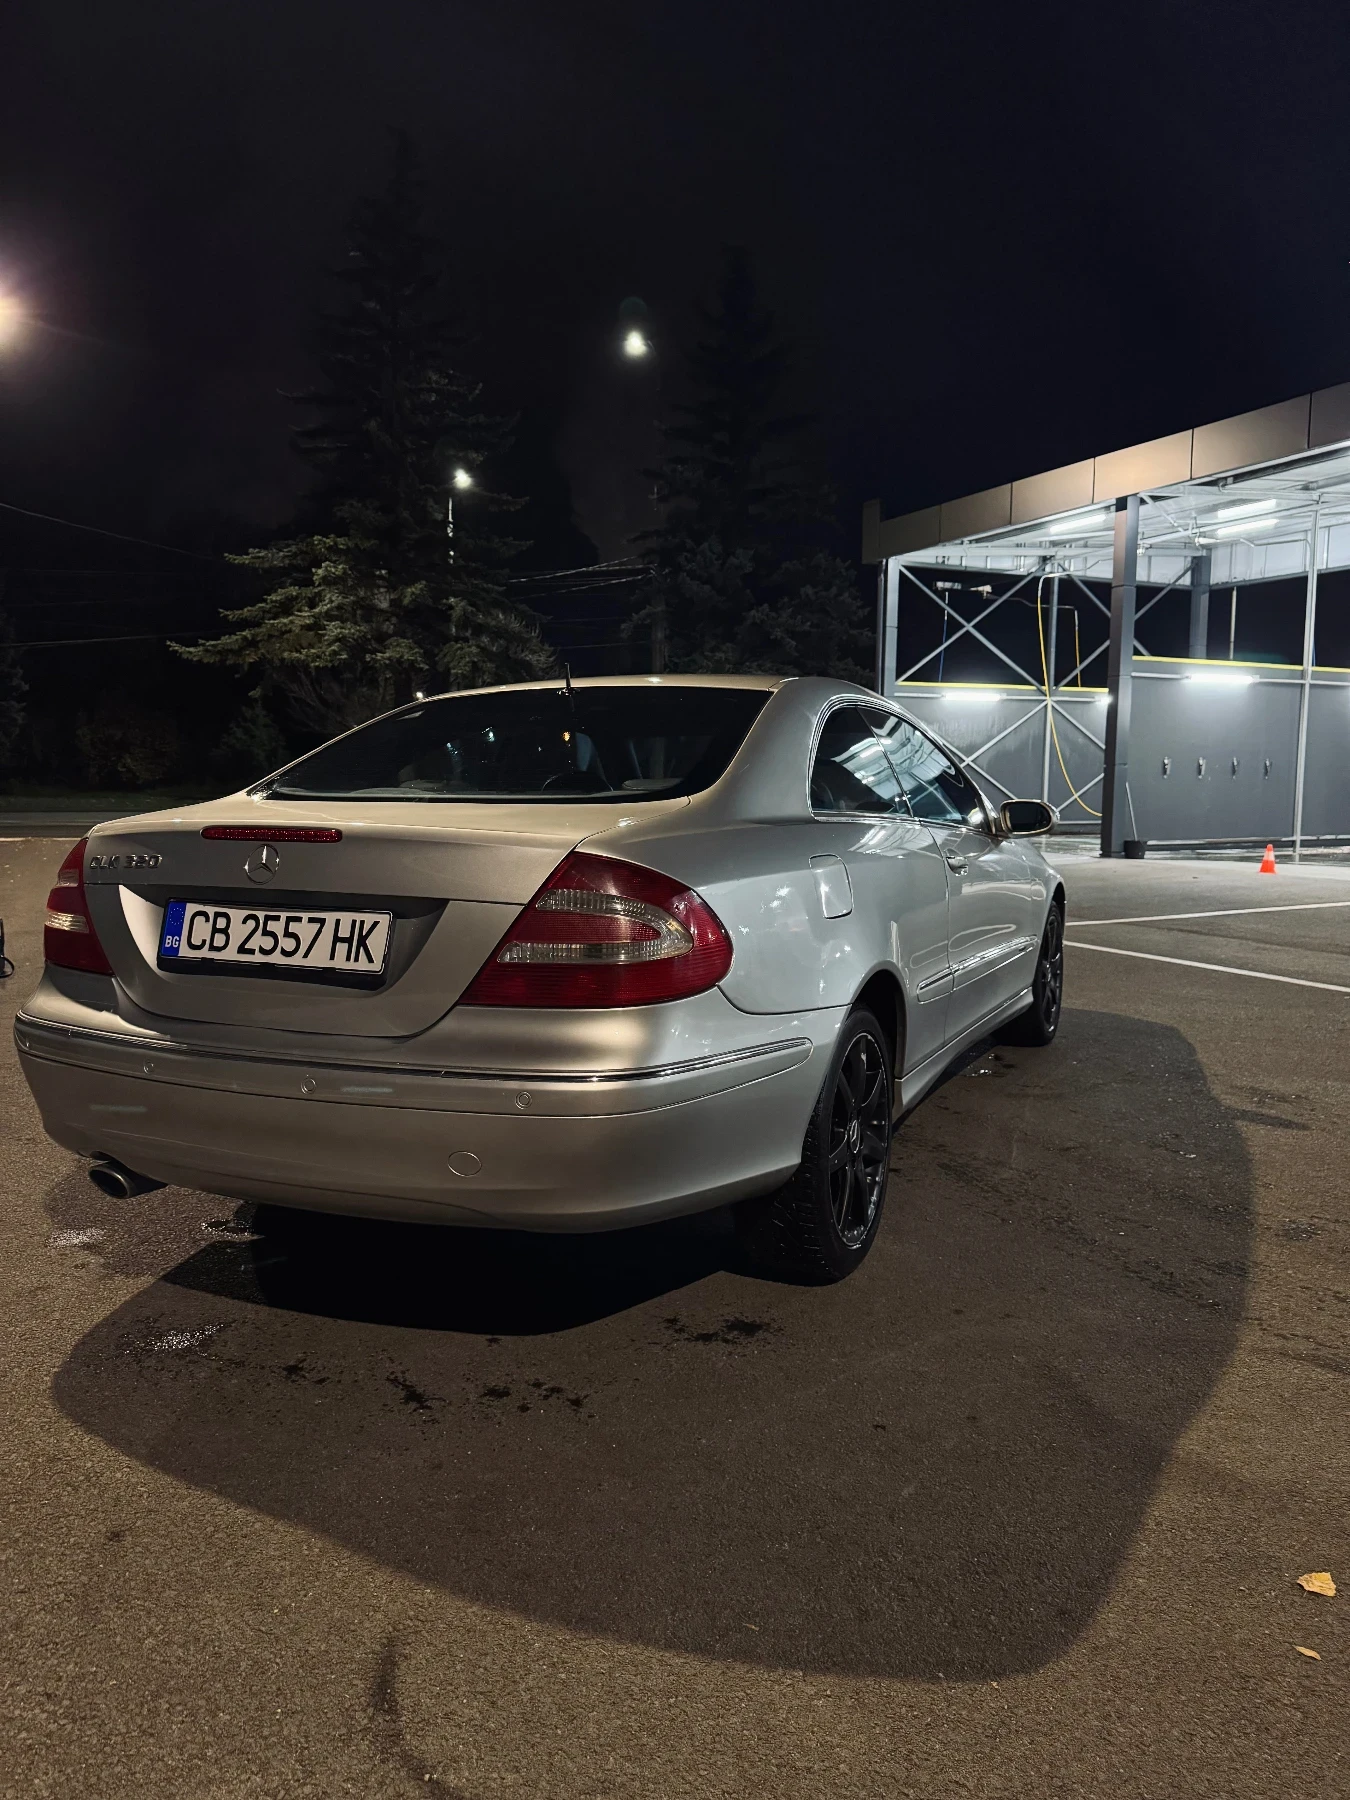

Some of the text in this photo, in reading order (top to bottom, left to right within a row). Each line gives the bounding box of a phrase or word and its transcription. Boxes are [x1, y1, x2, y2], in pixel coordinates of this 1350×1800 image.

[89, 854, 163, 869] CLK 320
[165, 935, 180, 948] BG
[186, 910, 381, 964] CB 2557 HK
